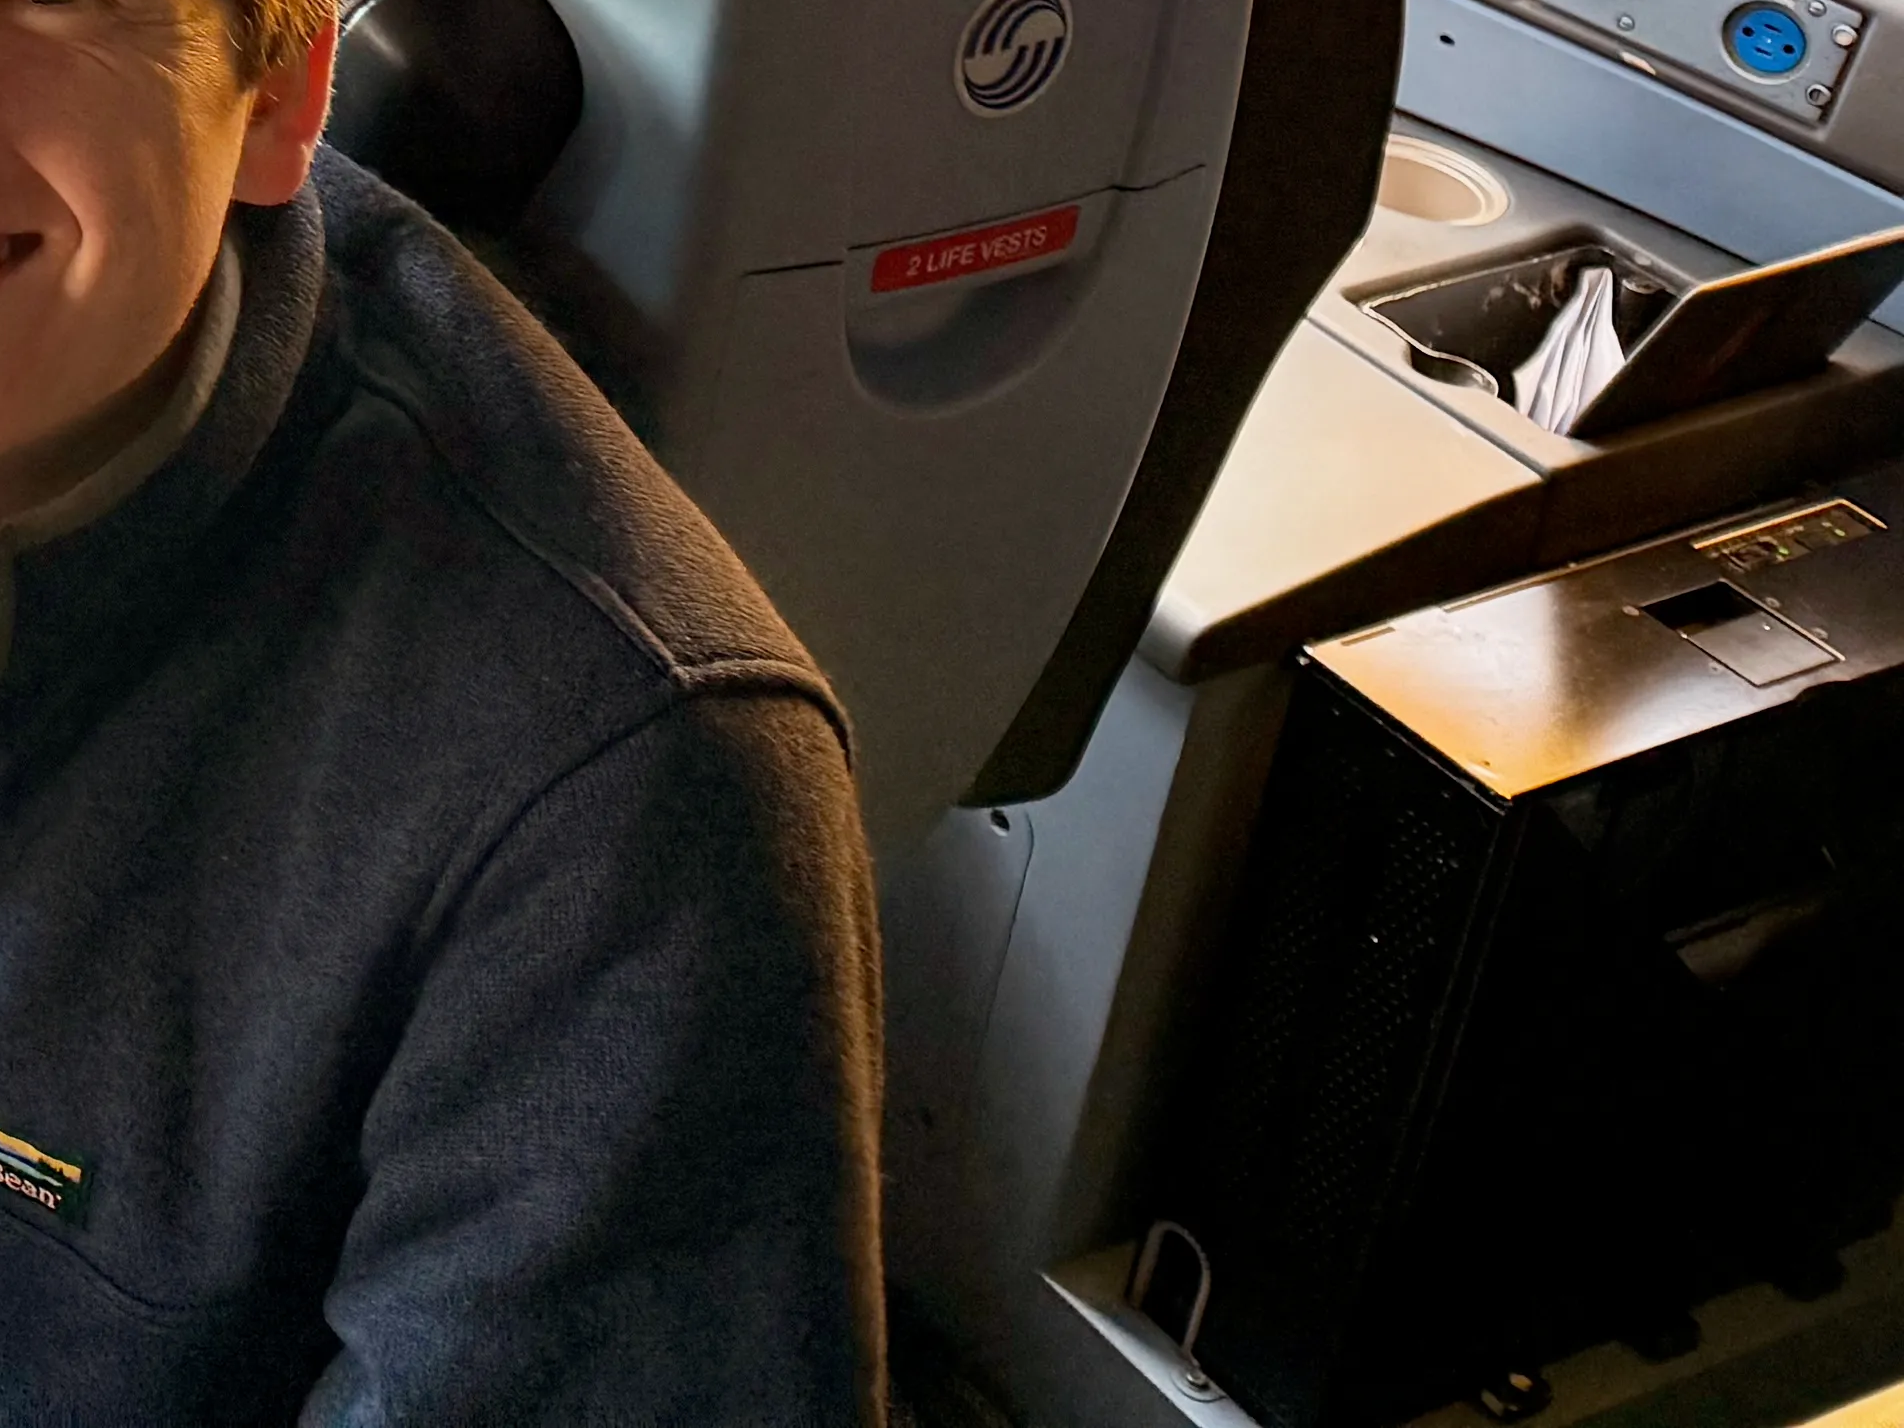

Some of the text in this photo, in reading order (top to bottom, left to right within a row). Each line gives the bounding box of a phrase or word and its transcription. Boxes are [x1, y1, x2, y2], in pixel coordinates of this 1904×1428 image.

[906, 225, 1048, 277] 2 LIFE VESTS
